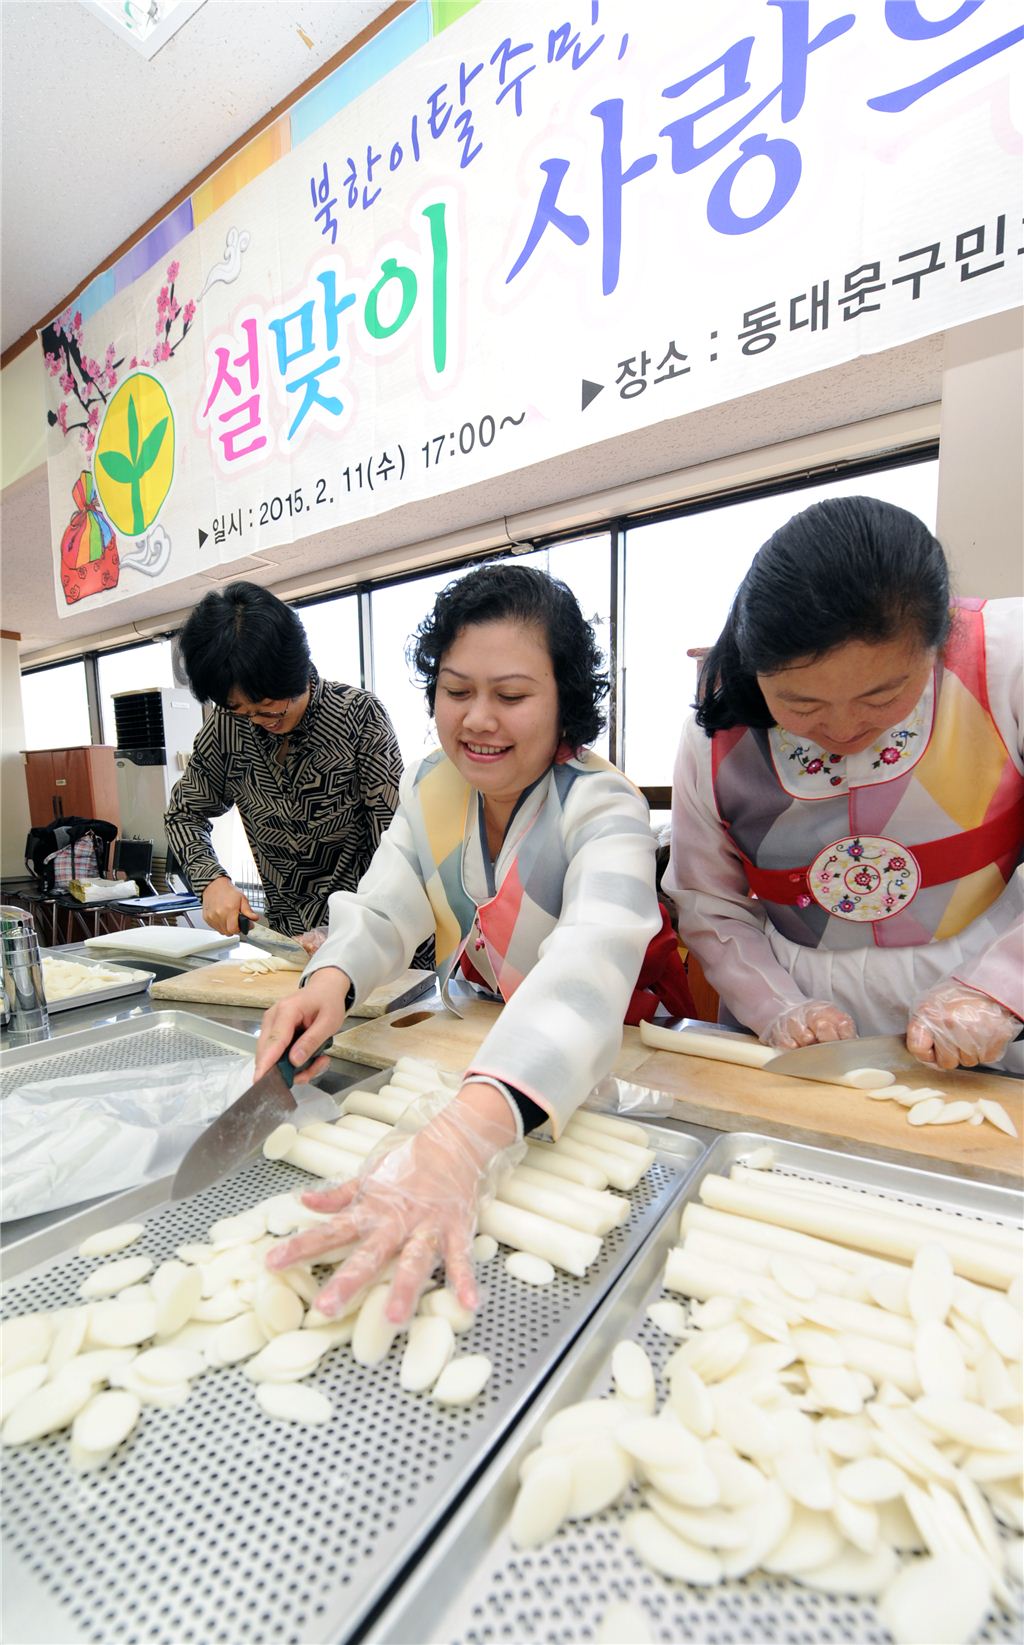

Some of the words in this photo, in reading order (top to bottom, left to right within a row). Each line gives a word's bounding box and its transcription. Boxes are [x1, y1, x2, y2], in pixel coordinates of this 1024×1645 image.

[203, 202, 447, 463] 설맞이
[614, 340, 691, 400] 장소
[737, 213, 1024, 357] 동대문구민
[212, 508, 243, 545] 일시
[259, 488, 311, 526] 2015.
[315, 478, 334, 505] 2.
[342, 444, 406, 492] 11(수)
[421, 411, 526, 469] 17:00~
